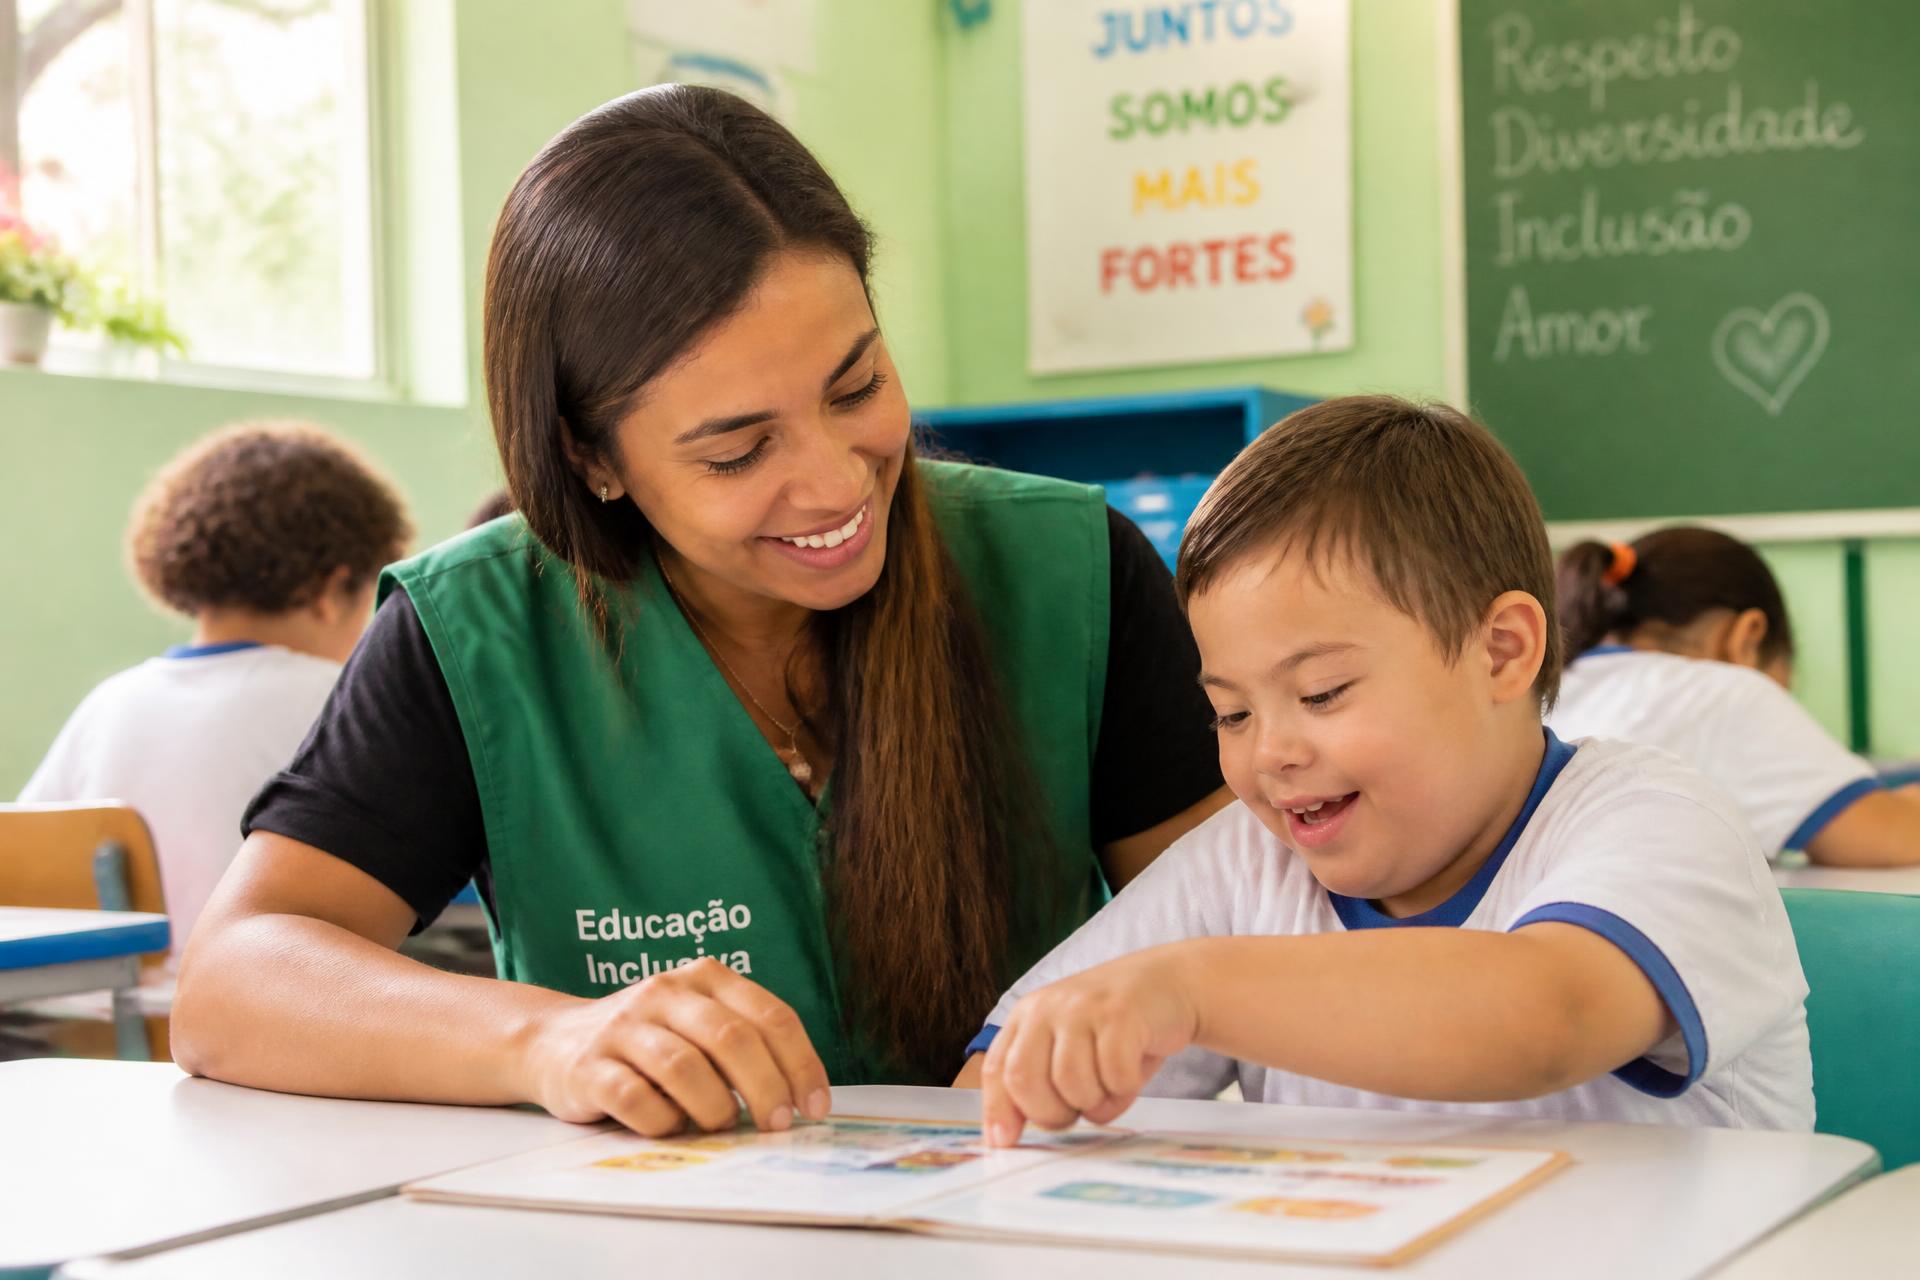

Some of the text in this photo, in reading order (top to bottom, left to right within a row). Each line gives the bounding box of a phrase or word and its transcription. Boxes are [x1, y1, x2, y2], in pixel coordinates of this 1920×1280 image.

[1092, 0, 1293, 58] JUNTOS
[1492, 0, 1741, 110] Respeito
[1108, 76, 1291, 140] SOMOS
[1492, 82, 1863, 178] Diversidade
[1132, 157, 1261, 216] MAIS
[1494, 189, 1751, 266] Inclusão
[1101, 232, 1295, 296] FORTES
[1494, 286, 1651, 362] Amor
[576, 899, 751, 943] Educação
